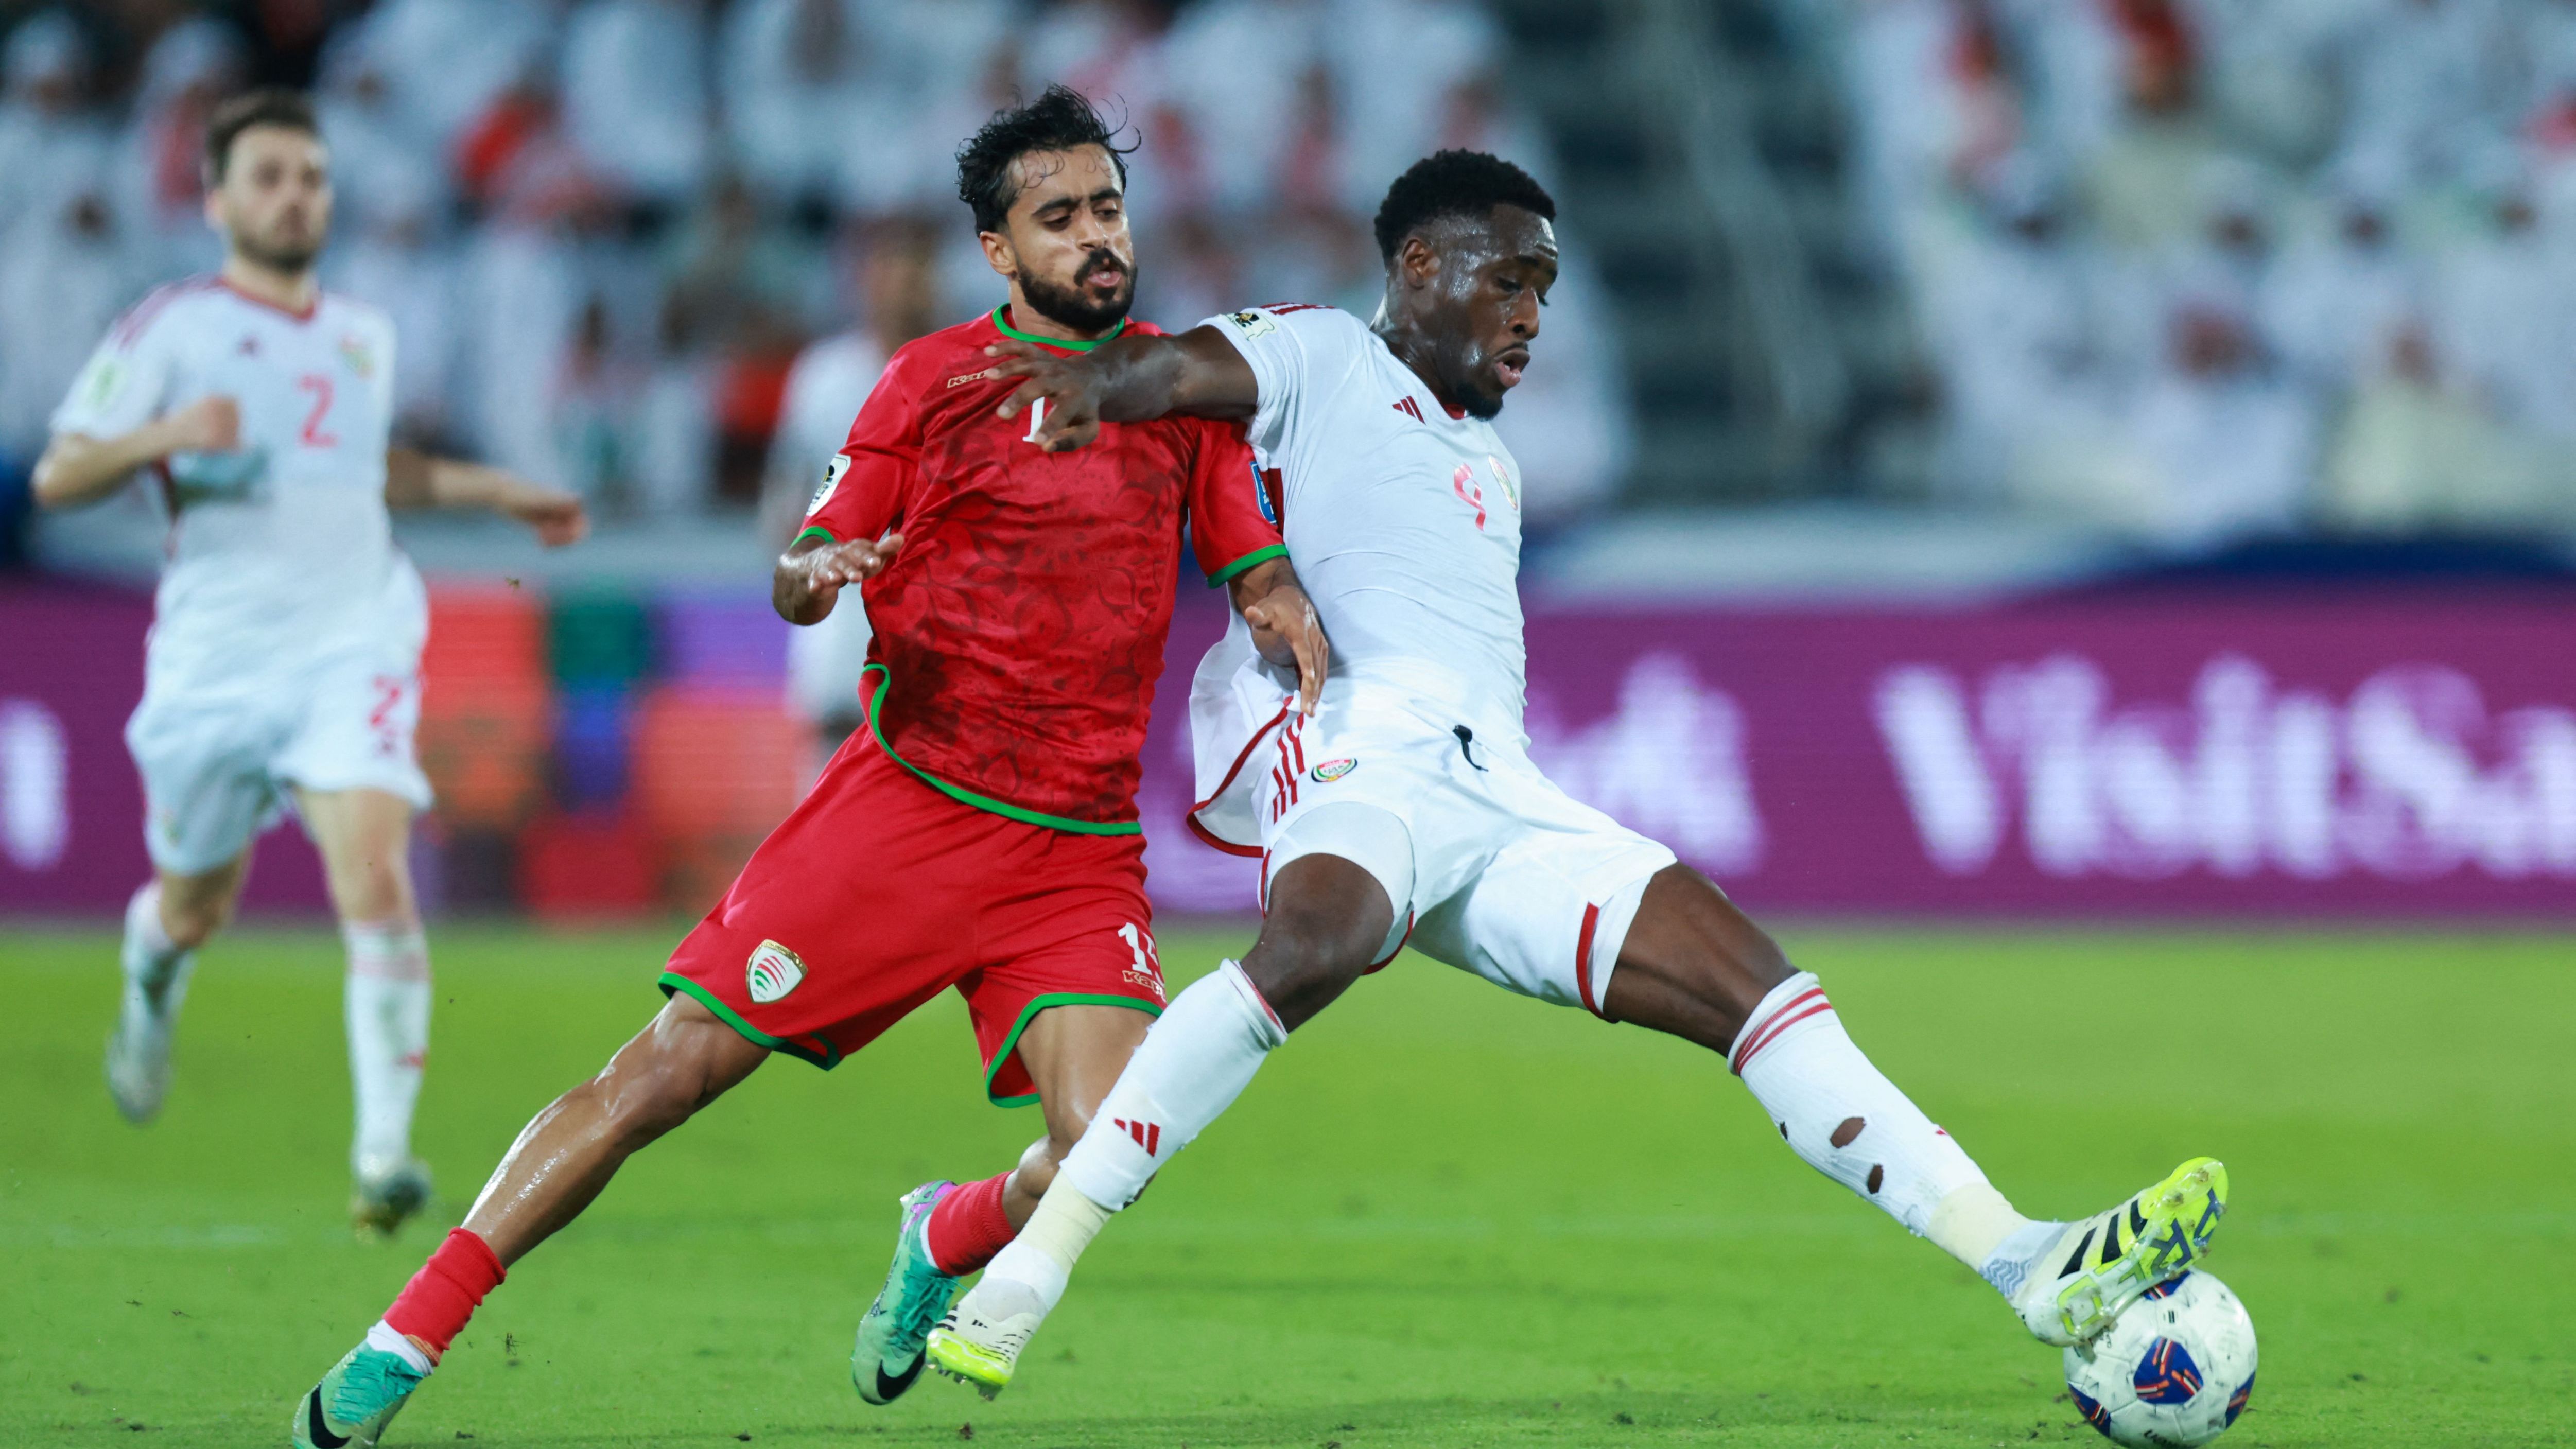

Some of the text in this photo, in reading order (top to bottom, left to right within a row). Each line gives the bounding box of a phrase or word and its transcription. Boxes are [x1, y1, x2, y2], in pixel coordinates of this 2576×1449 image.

[297, 373, 338, 449] 2
[1453, 463, 1486, 532] 9
[368, 673, 406, 735] 2
